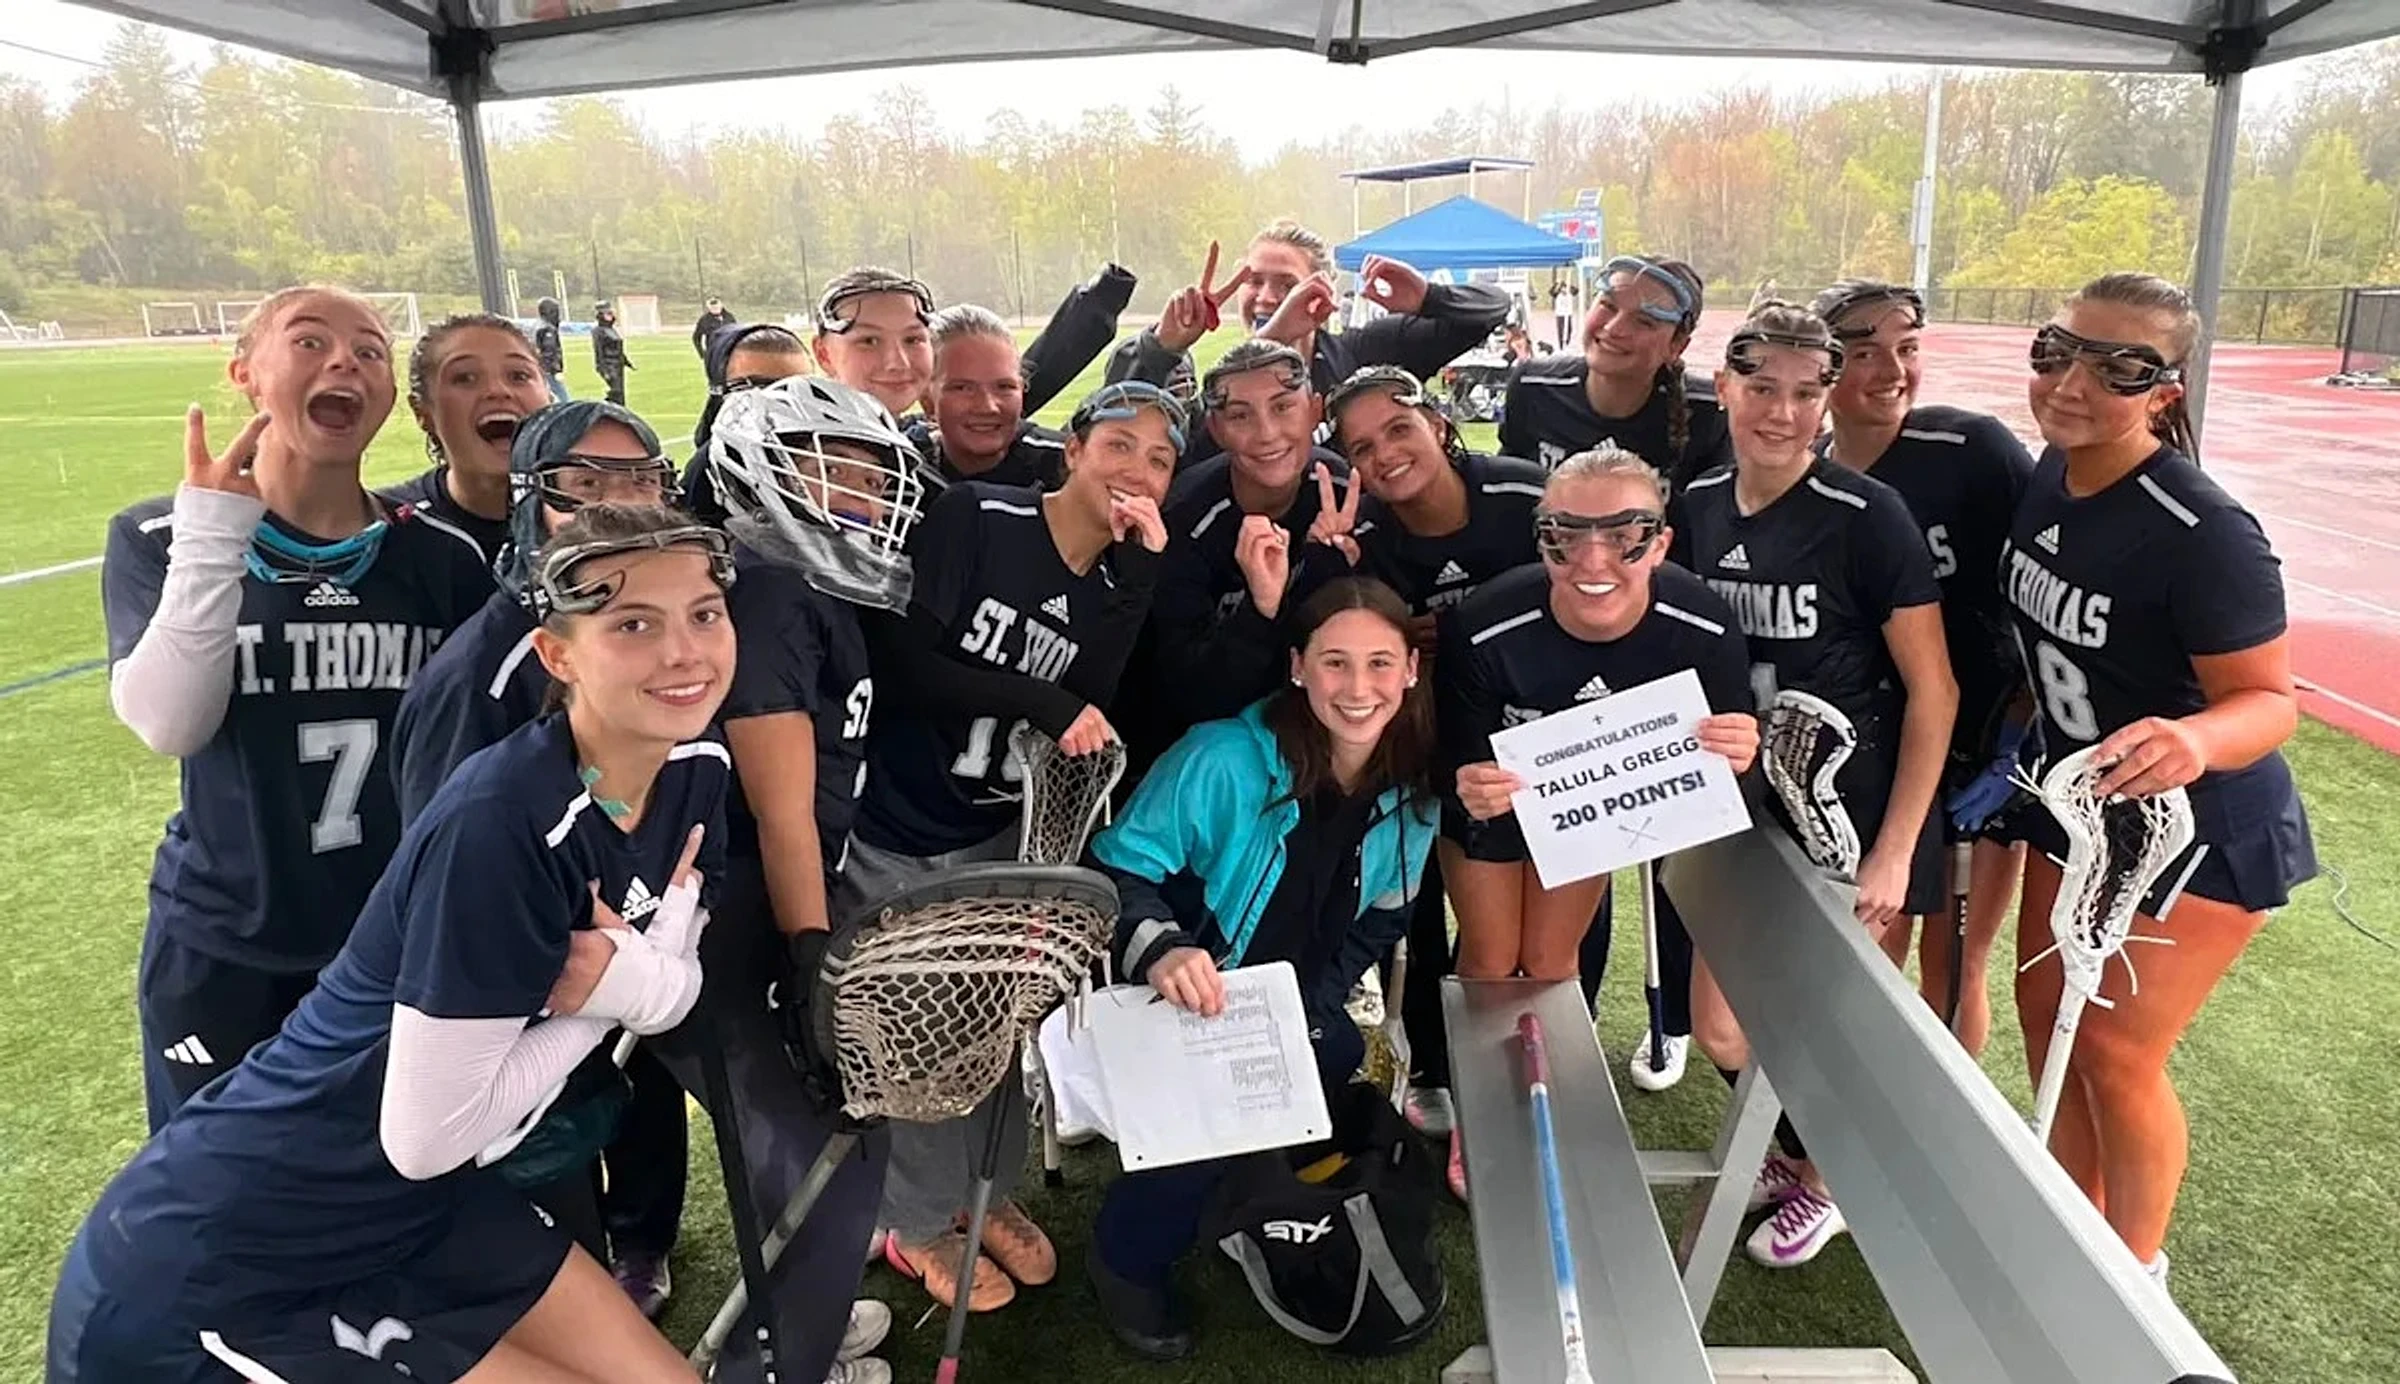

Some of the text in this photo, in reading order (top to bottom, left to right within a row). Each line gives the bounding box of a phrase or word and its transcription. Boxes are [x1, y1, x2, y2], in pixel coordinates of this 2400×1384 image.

[303, 594, 361, 607] adidas
[2009, 548, 2113, 649] THOMAS
[1533, 712, 1679, 767] CONGRATULATIONS
[1533, 736, 1700, 800] TALULA GREGG
[298, 718, 379, 855] 7
[1551, 770, 1707, 832] 200 POINTS!
[1262, 1214, 1334, 1244] STX
